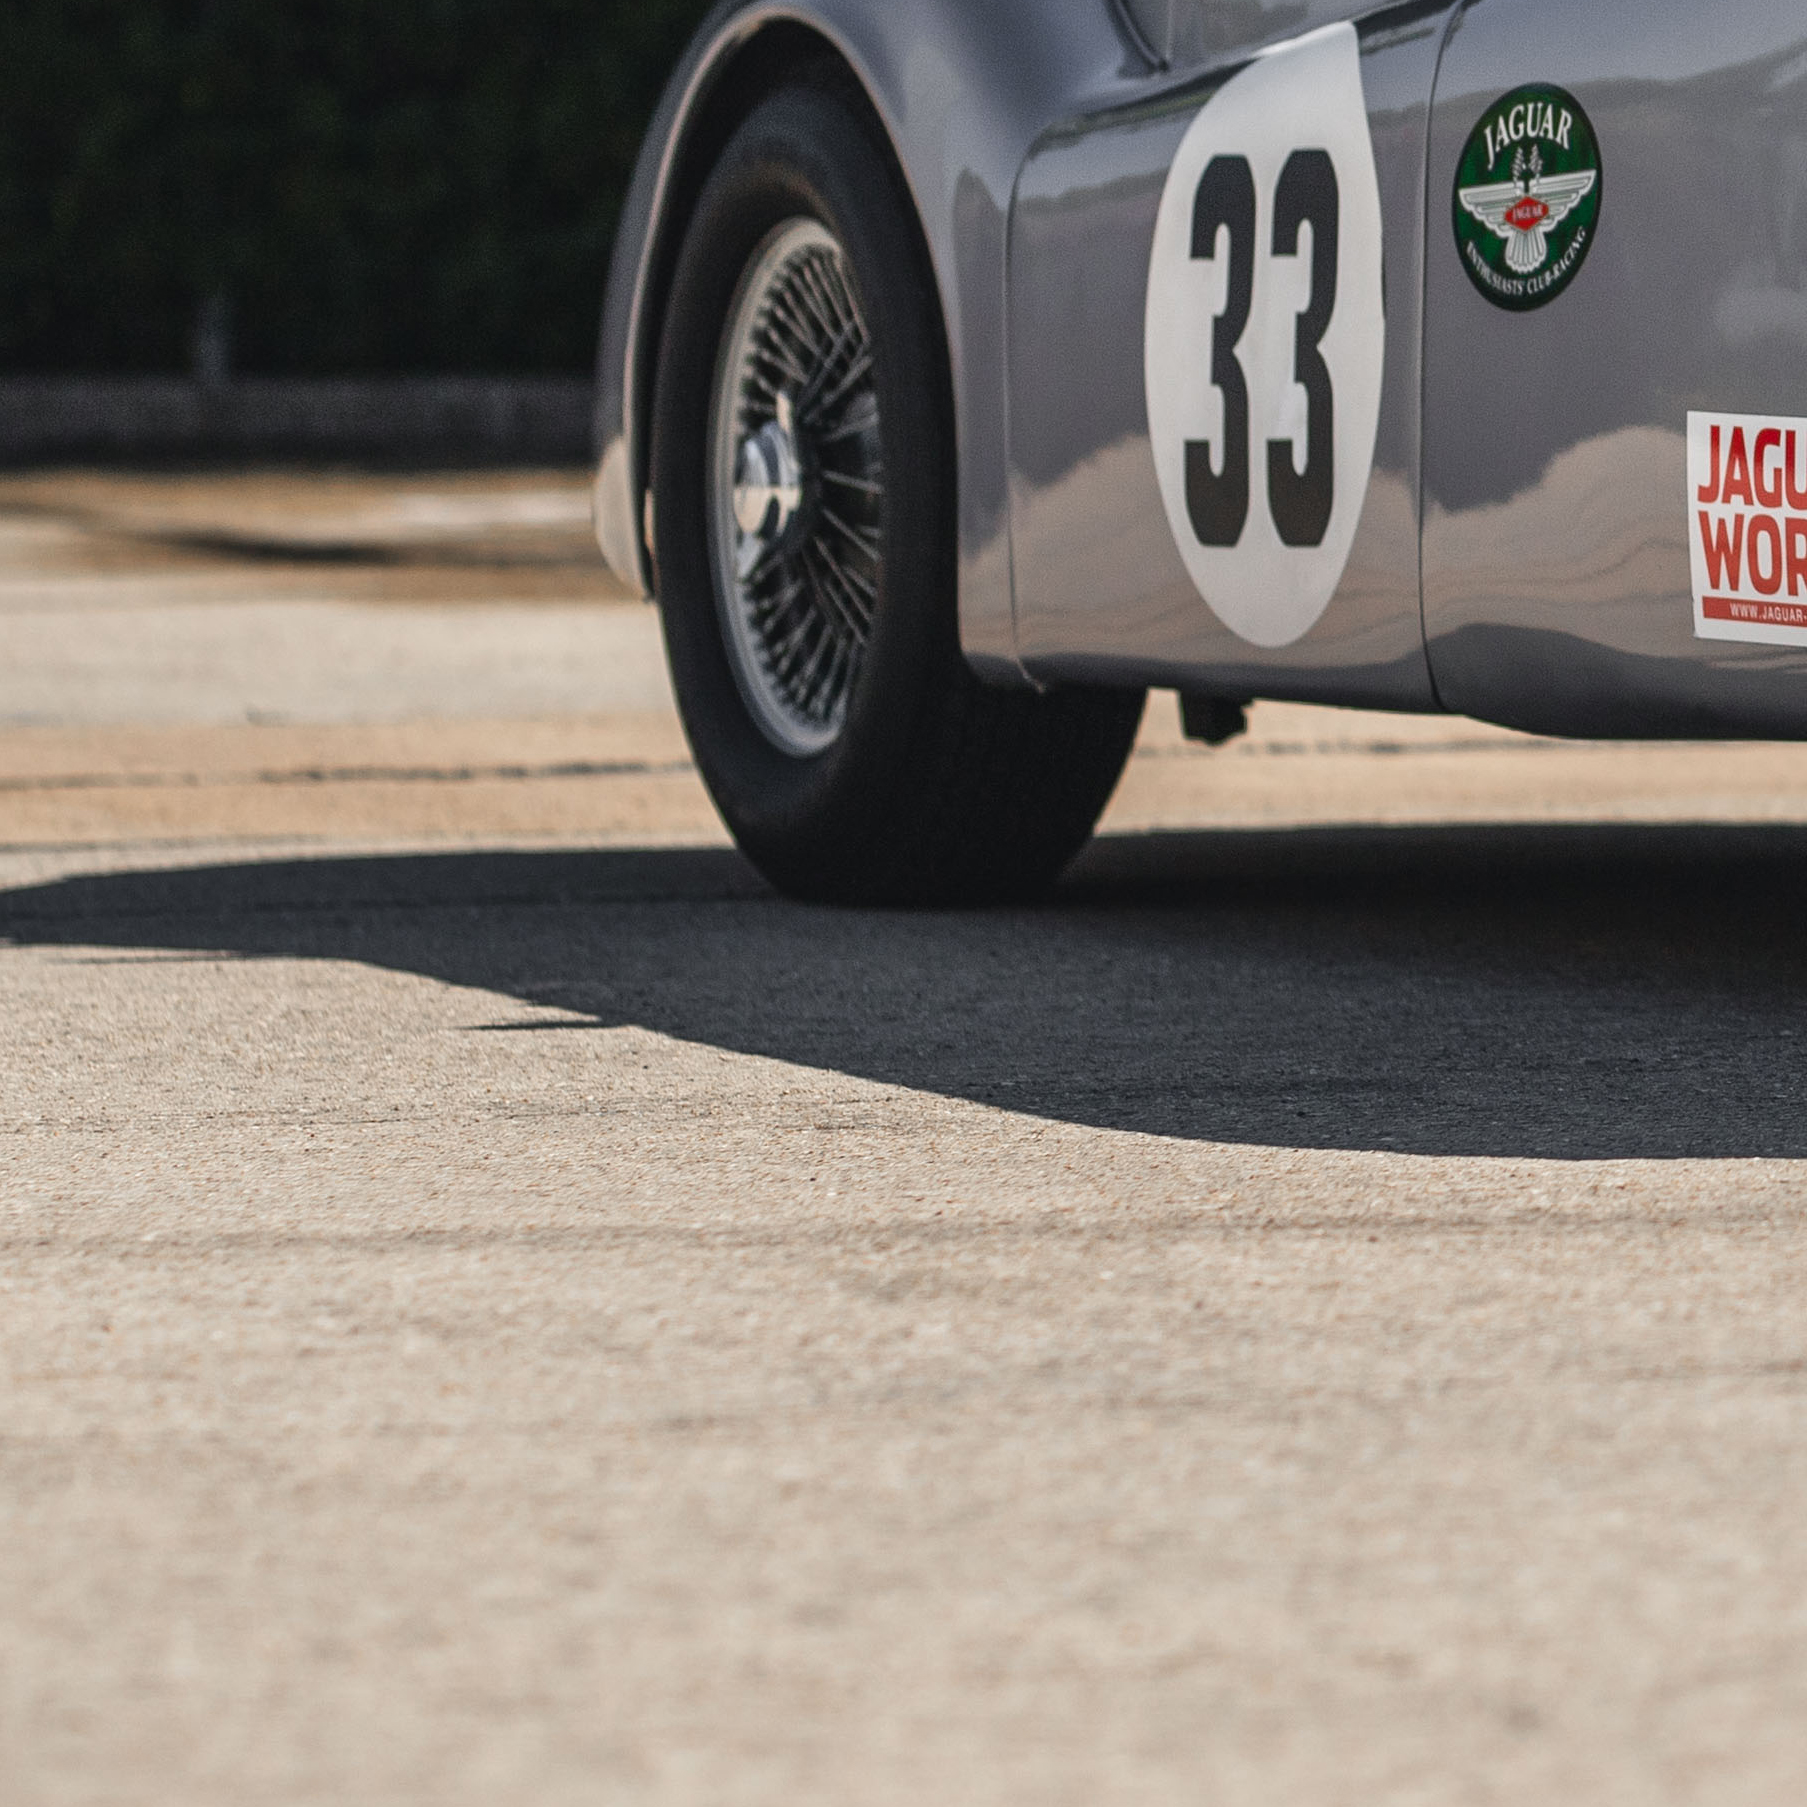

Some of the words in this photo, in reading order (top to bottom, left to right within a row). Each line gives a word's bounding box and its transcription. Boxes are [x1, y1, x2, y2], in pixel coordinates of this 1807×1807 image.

[1484, 101, 1573, 171] JAGUAR
[1513, 205, 1543, 221] JAGUAR
[1184, 148, 1340, 548] 33
